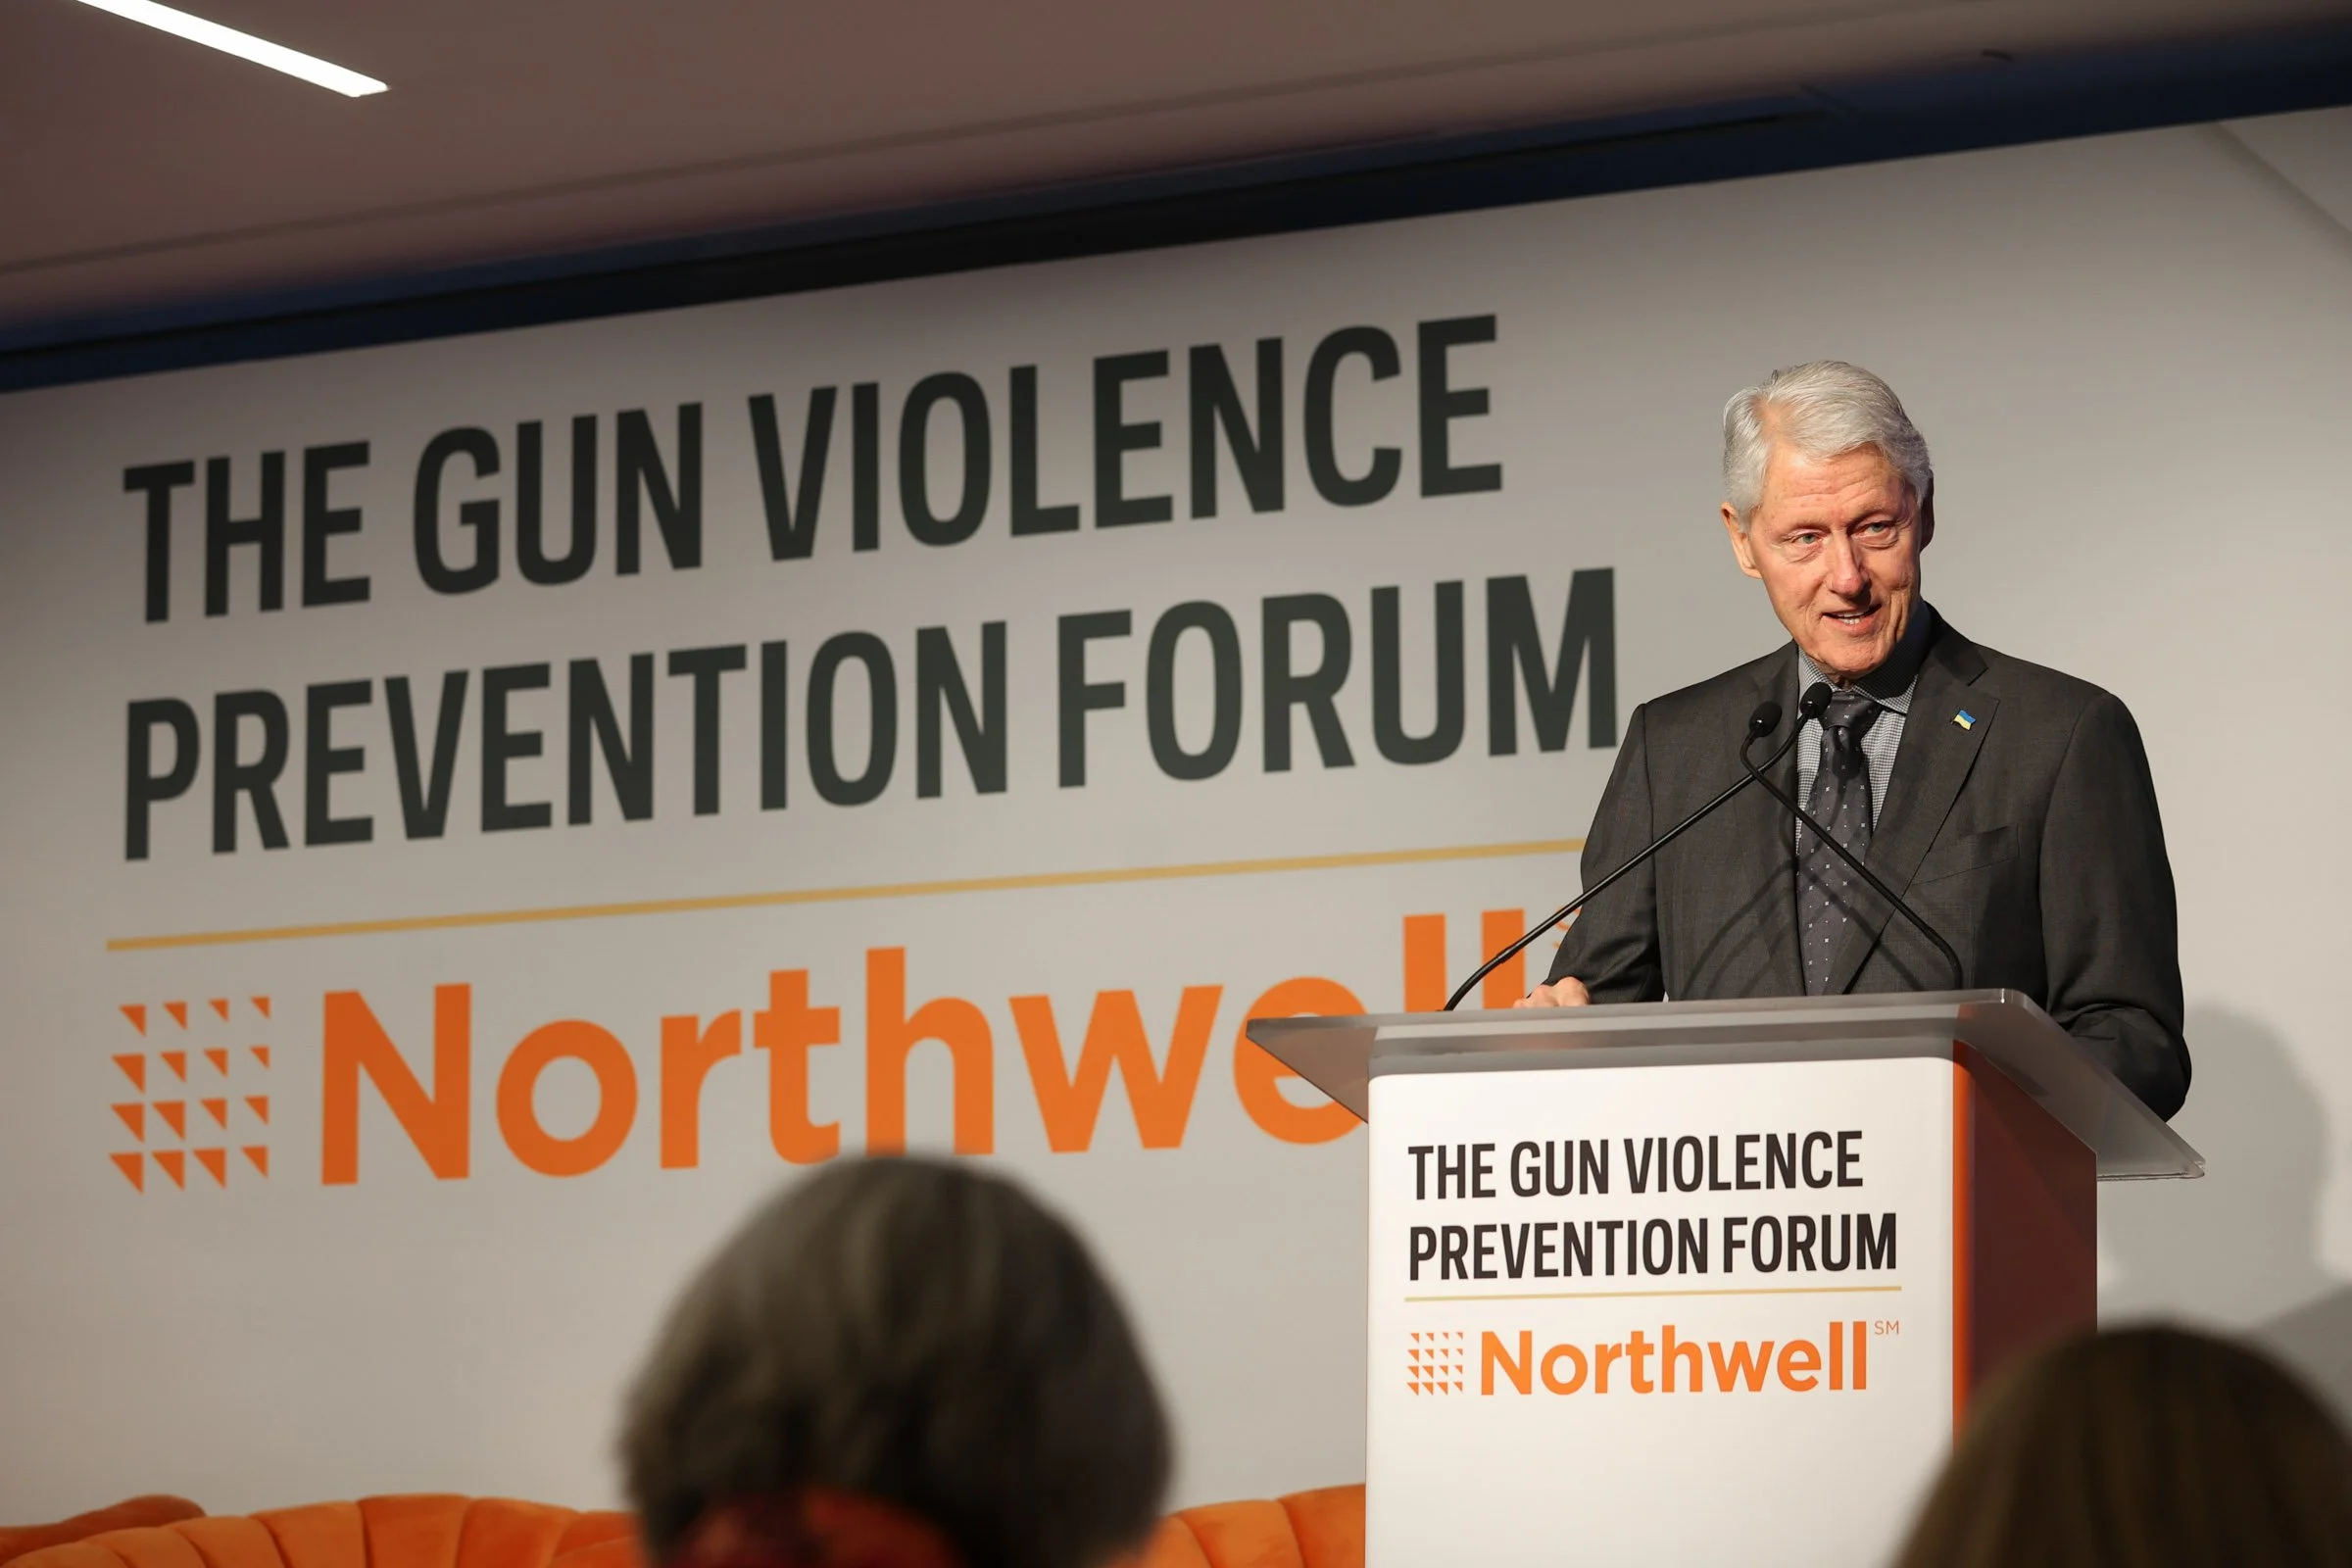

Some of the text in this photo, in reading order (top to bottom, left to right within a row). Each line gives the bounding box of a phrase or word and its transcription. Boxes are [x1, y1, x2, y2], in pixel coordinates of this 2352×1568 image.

[122, 313, 1503, 625] THE GUN VIOLENCE
[124, 566, 1618, 862] PREVENTION FORUM
[1407, 1130, 1864, 1200] THE GUN VIOLENCE
[1408, 1212, 1897, 1282] PREVENTION FORUM
[1480, 1319, 1901, 1396] Northwell SM
